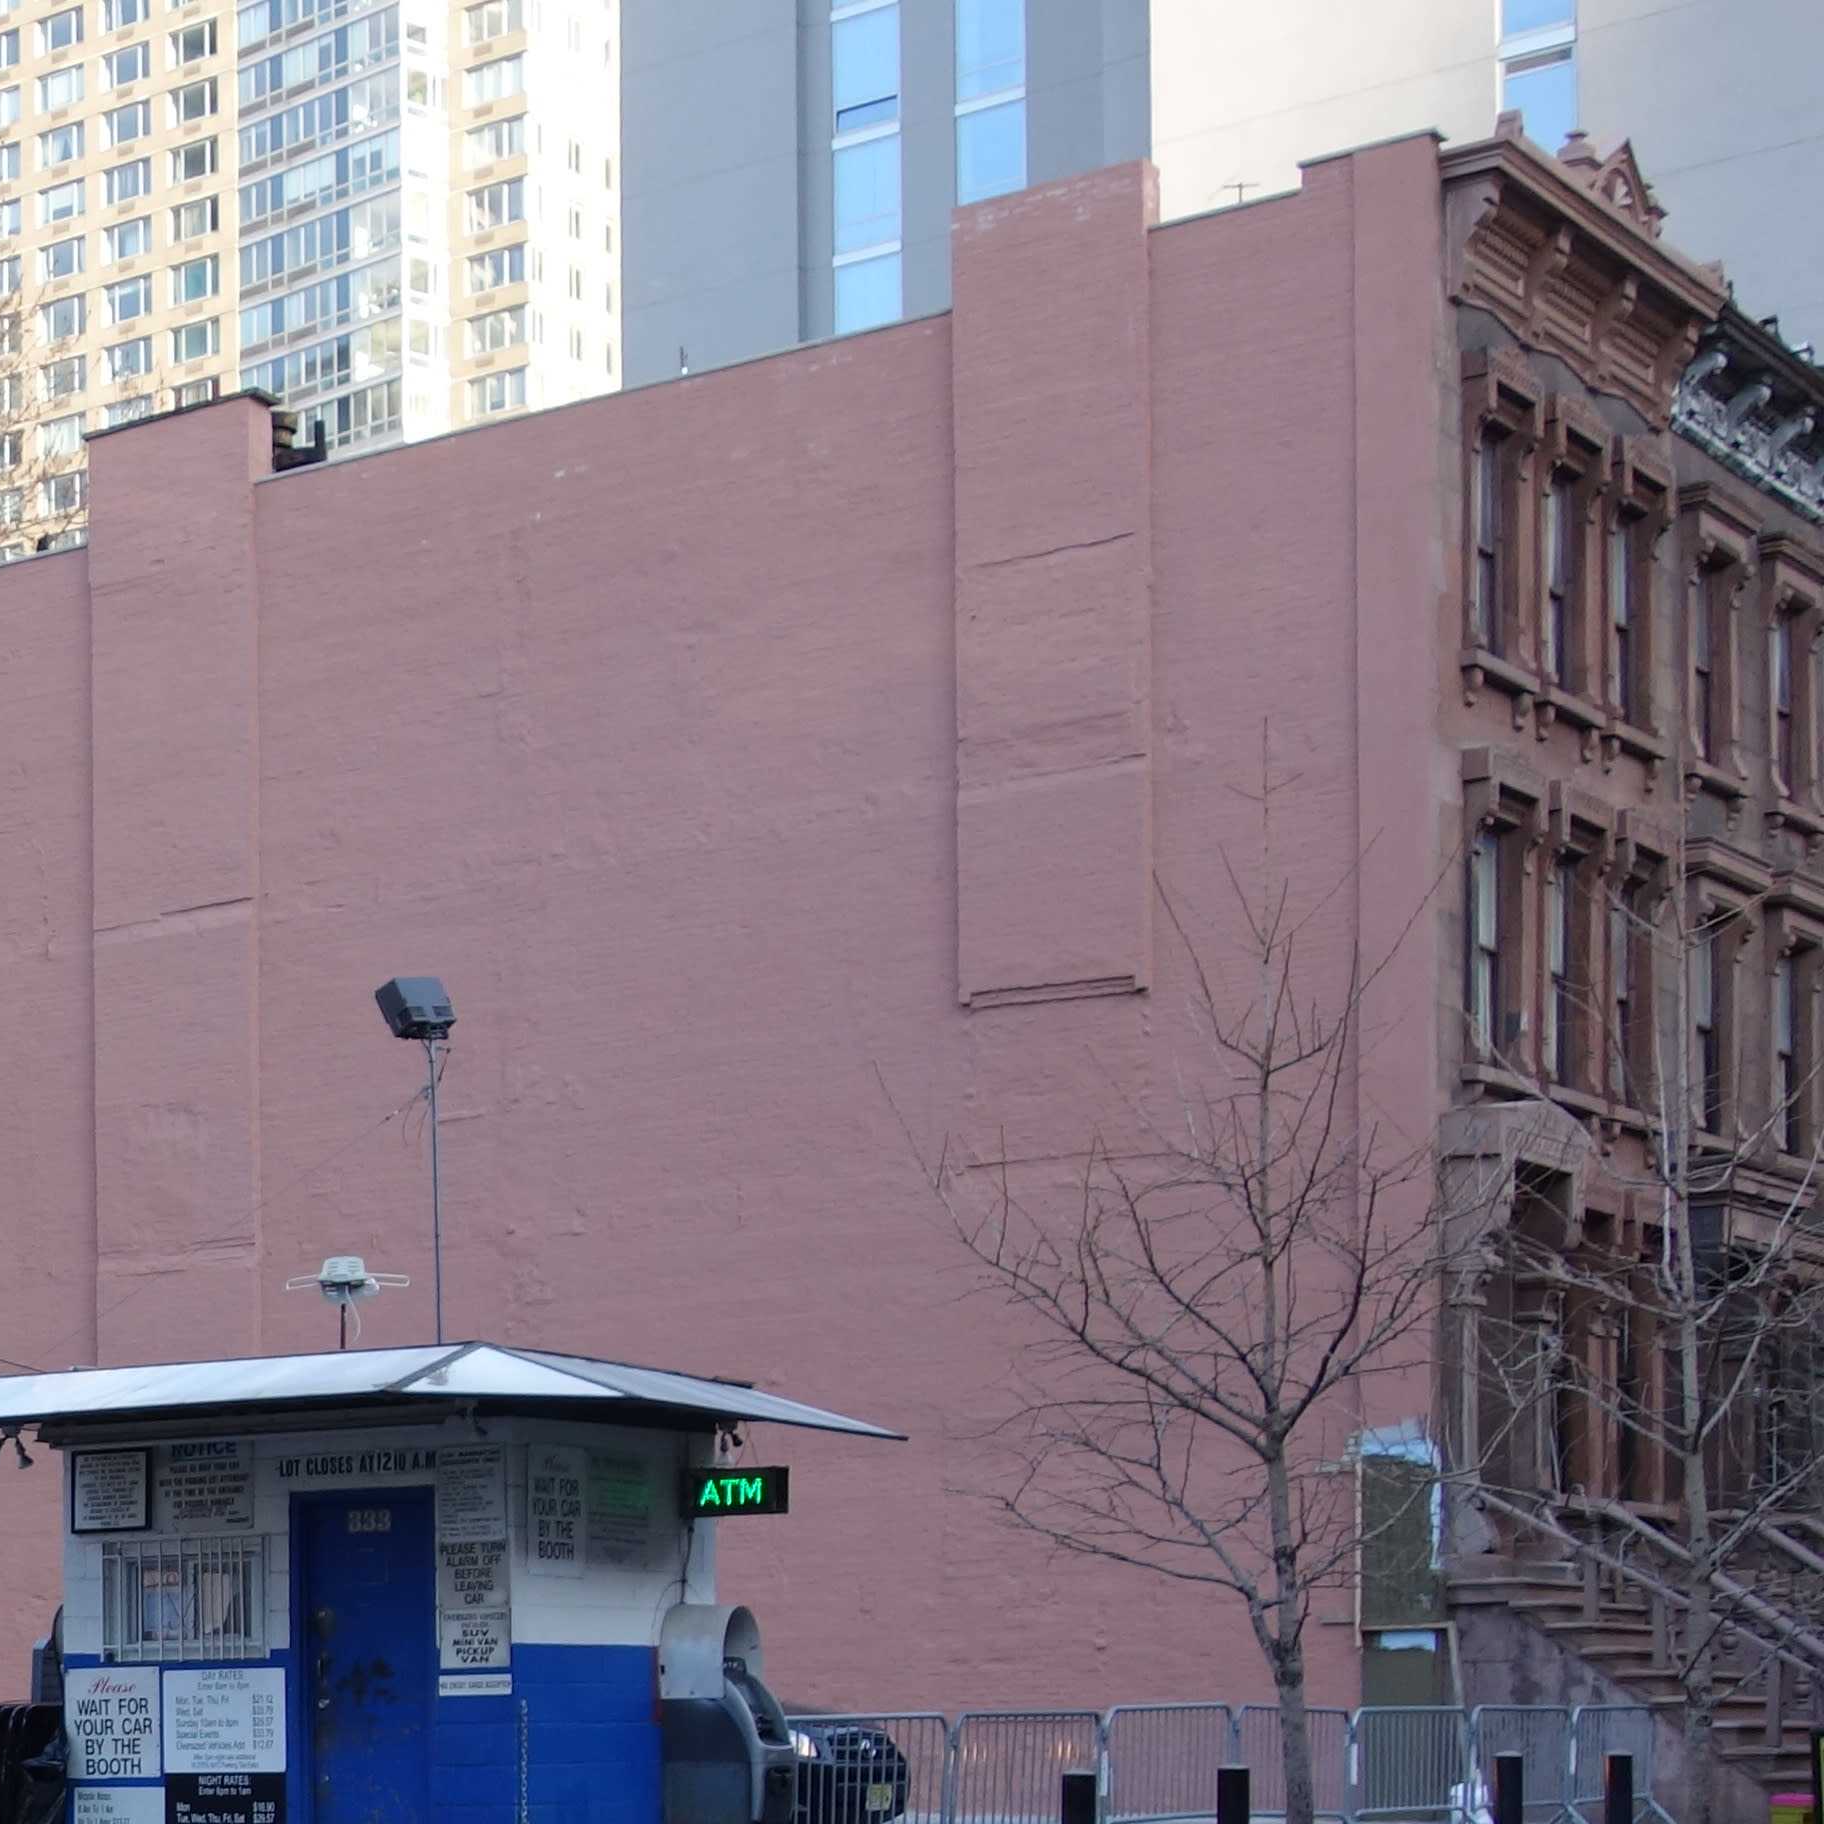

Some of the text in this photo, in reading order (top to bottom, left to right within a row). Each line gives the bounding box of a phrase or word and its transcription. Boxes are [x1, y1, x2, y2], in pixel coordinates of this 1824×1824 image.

[280, 1458, 300, 1477] LOT
[306, 1455, 353, 1476] CLOSES
[559, 1478, 580, 1496] FOR
[700, 1477, 763, 1507] ATM
[538, 1520, 574, 1539] BY THE
[440, 1542, 476, 1556] PLEASE
[538, 1541, 575, 1561] BOOTH
[446, 1554, 502, 1567] ALARM OFF
[454, 1567, 492, 1579] BEFORE
[455, 1580, 494, 1592] LEAVING
[464, 1593, 485, 1605] CAR
[462, 1629, 489, 1637] SUV
[456, 1646, 495, 1656] PICKUP
[461, 1655, 489, 1664] VAN
[88, 1676, 137, 1694] Please
[77, 1697, 149, 1716] WAIT FOR
[73, 1717, 153, 1736] YOUR CAR
[85, 1737, 141, 1755] BY THE
[85, 1757, 142, 1776] BOOTH
[198, 1775, 223, 1786] NIGHT
